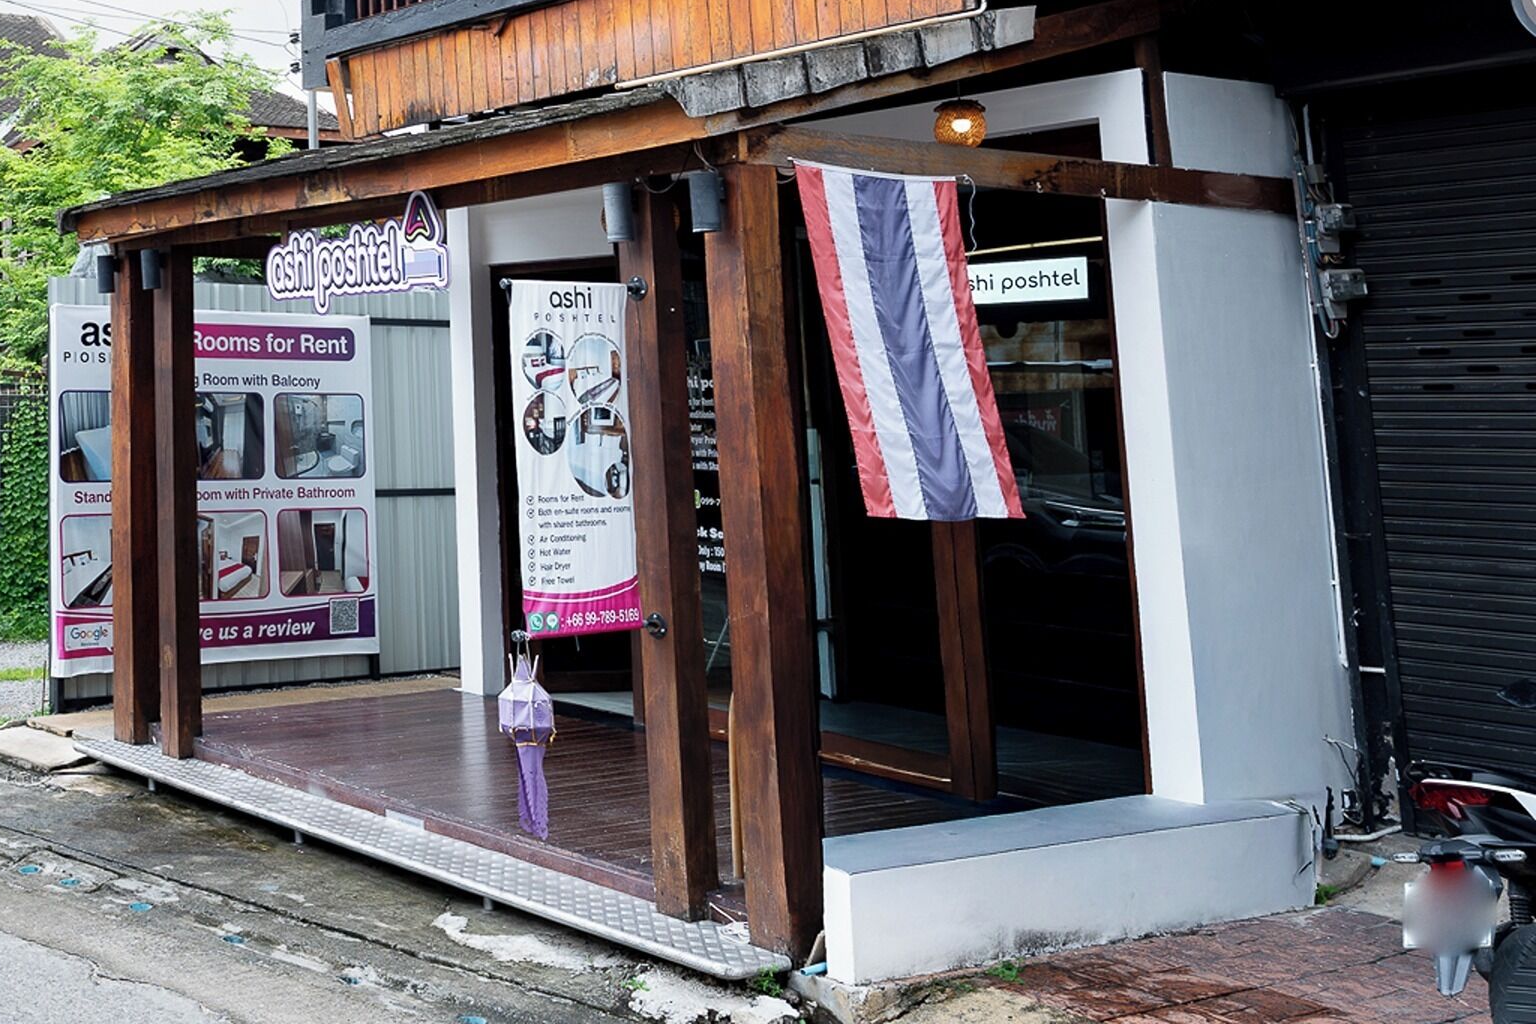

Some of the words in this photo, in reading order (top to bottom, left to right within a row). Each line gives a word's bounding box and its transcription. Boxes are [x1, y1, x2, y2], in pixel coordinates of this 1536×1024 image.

[271, 235, 314, 294] ashi
[316, 225, 402, 309] poshtel
[1001, 267, 1081, 295] poshtel
[549, 285, 592, 309] ashi
[534, 312, 617, 324] POSHTEL
[194, 330, 261, 353] Rooms
[265, 332, 296, 353] for
[299, 333, 349, 355] Rent
[202, 372, 240, 387] Room
[242, 373, 268, 387] with
[271, 373, 321, 390] Balcony
[224, 487, 250, 500] with
[252, 486, 294, 500] Private
[297, 485, 356, 499] Bathroom
[537, 495, 559, 504] Rooms
[560, 494, 569, 503] for
[570, 493, 584, 502] Rent
[580, 506, 600, 514] rooms
[600, 505, 613, 514] and
[539, 535, 548, 543] Air
[549, 534, 587, 544] Conditioning
[539, 548, 552, 557] Hot
[553, 547, 571, 557] Water
[539, 562, 553, 571] Hair
[554, 561, 571, 572] Dryer
[540, 576, 555, 585] Free
[556, 575, 575, 585] Towel
[566, 612, 584, 628] +66
[70, 625, 109, 641] Google
[218, 627, 238, 641] us
[242, 626, 253, 639] a
[257, 618, 316, 638] review
